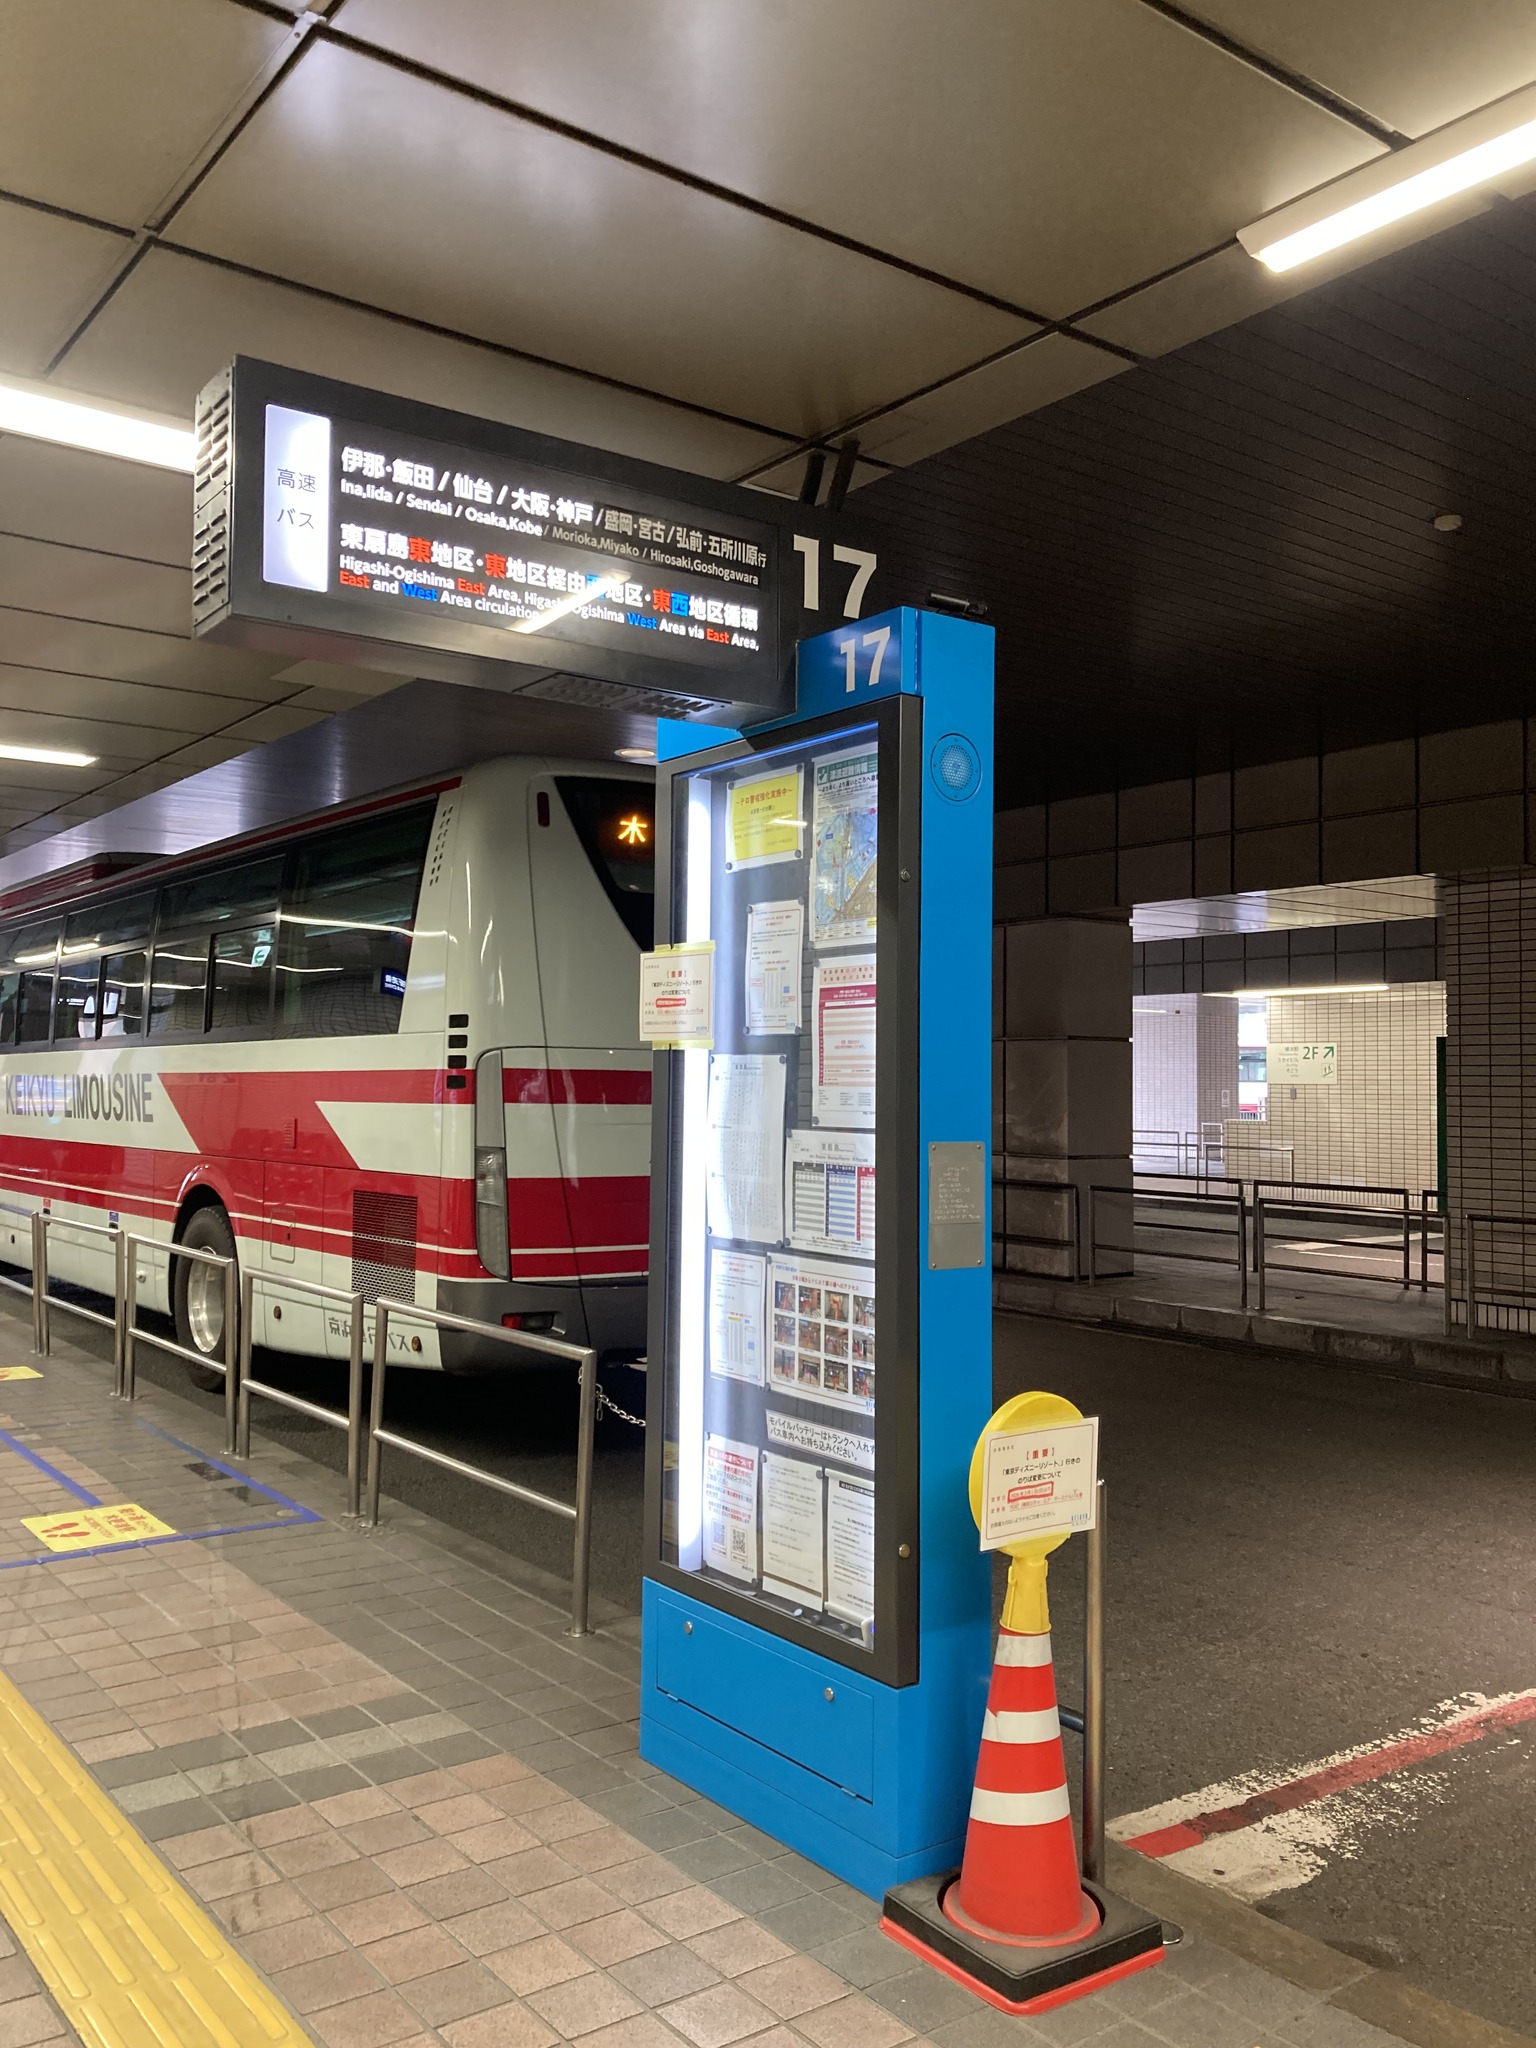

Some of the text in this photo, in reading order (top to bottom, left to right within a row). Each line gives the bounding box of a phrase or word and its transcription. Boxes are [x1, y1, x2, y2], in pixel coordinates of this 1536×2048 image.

[277, 468, 316, 493] 高速
[341, 447, 434, 491] 伊那・飯田
[453, 473, 494, 505] 仙台
[511, 488, 593, 524] 大阪・神戸
[277, 508, 315, 529] バス
[406, 494, 452, 517] Sendai
[465, 507, 543, 536] Osaka,Kobe
[552, 526, 640, 558] Morioka,Miyako
[650, 549, 760, 586] Hirosaki,Goshogawara
[340, 570, 371, 589] East
[372, 579, 400, 595] and
[402, 583, 438, 602] West
[440, 592, 472, 609] Area
[793, 534, 877, 619] 17
[340, 555, 455, 590] Higashi-Ogishima
[457, 579, 486, 596] East
[488, 584, 522, 604] Area,
[627, 612, 657, 630] West
[659, 618, 687, 636] Area
[688, 626, 704, 640] via
[706, 629, 730, 644] East
[731, 634, 760, 652] Area,
[840, 625, 891, 693] 17
[618, 816, 648, 844] 木
[1302, 1046, 1319, 1060] 2F
[6, 1073, 154, 1123] KEIKYU LIMOUSINE
